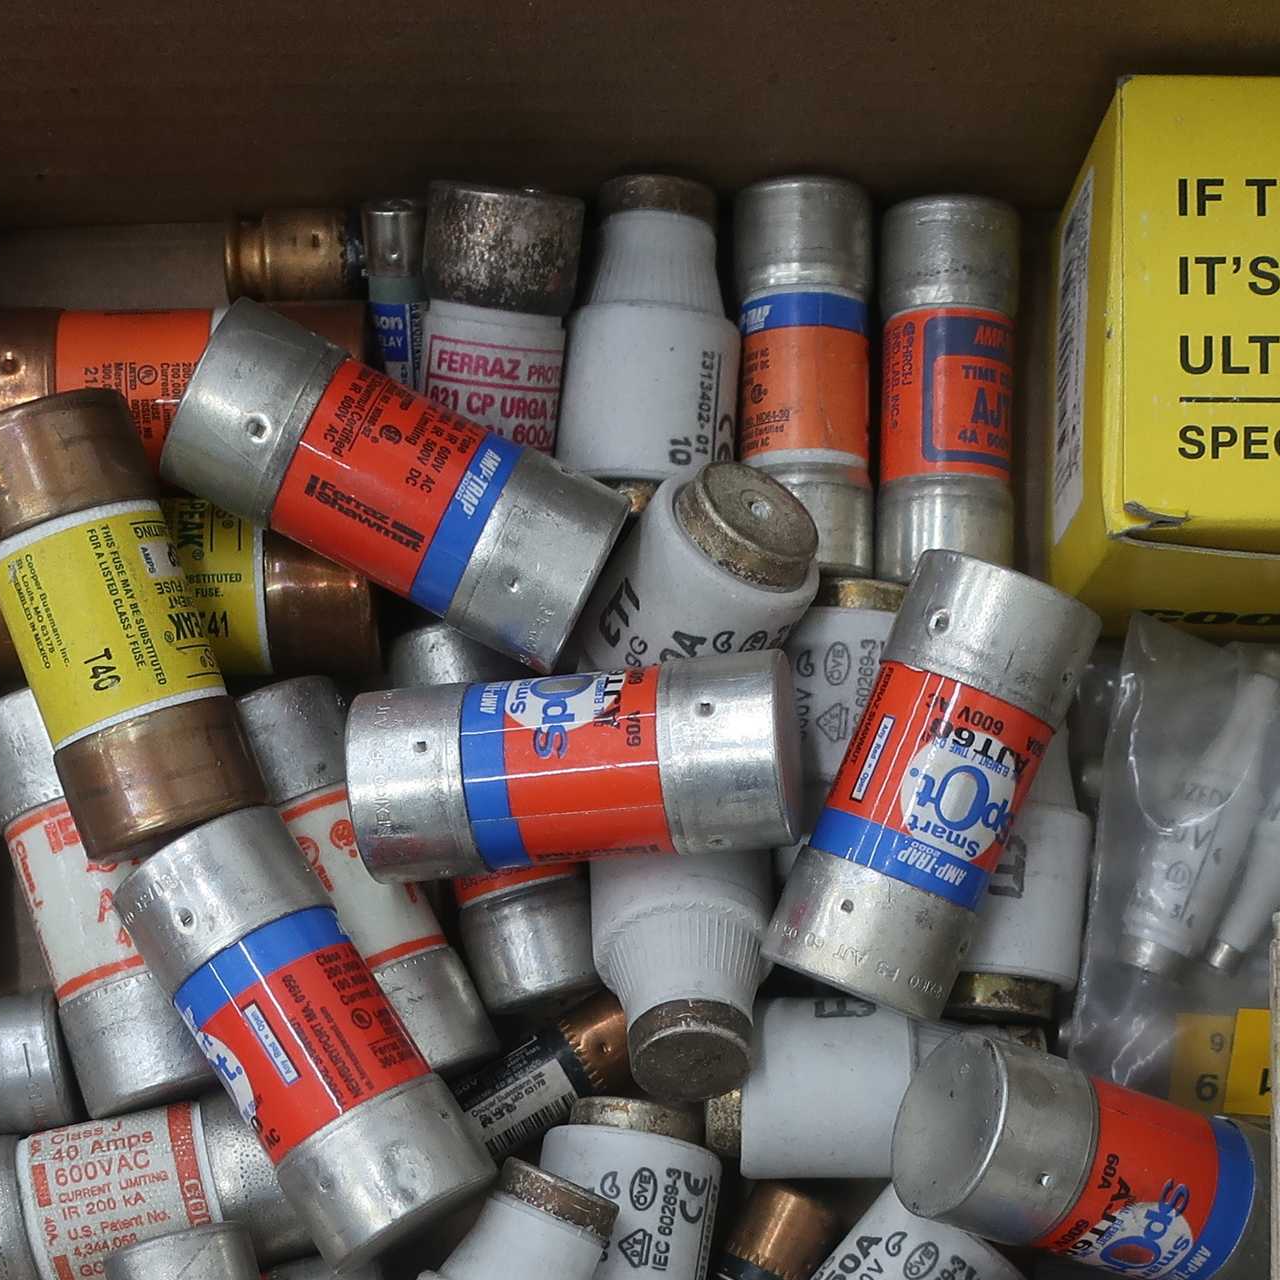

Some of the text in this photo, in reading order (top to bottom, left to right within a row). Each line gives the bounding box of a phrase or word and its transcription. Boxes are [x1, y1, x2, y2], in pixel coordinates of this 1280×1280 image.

[1177, 179, 1225, 217] IF
[1177, 257, 1280, 297] IT'S
[437, 350, 521, 381] FERRAZ
[962, 365, 997, 384] TIME
[466, 392, 495, 416] CP
[324, 424, 339, 443] AC
[669, 436, 691, 465] 10
[405, 468, 422, 487] DC
[420, 474, 436, 494] AC
[461, 449, 502, 518] AMP-TRAP
[321, 481, 390, 524] Ferraz
[315, 491, 422, 552] Shawmut
[140, 546, 157, 574] AMPS
[24, 554, 43, 591] Cooper
[40, 589, 63, 645] Bussmann
[87, 528, 146, 672] FOR LISTED CLASS FUSE.
[99, 523, 168, 686] THIS FUSE MAY BE SUBSTITUTED
[195, 588, 224, 598] FUSE.
[626, 711, 640, 747] 60A
[958, 706, 1004, 735] 600V
[907, 814, 980, 857] Smart
[897, 847, 967, 885] AMP-TRAP
[311, 1023, 365, 1099] NEWBURYPORT
[51, 1120, 123, 1145] Class J
[52, 1130, 154, 1162] 40 Amps
[55, 1150, 150, 1187] 600VAC
[1098, 1153, 1120, 1189] 60A
[59, 1170, 169, 1204] CURRENT LIMITING
[62, 1191, 146, 1221] IR 200 kA
[651, 1168, 682, 1272] IEC 60269-3
[68, 1210, 171, 1241] U.S. Patent No.
